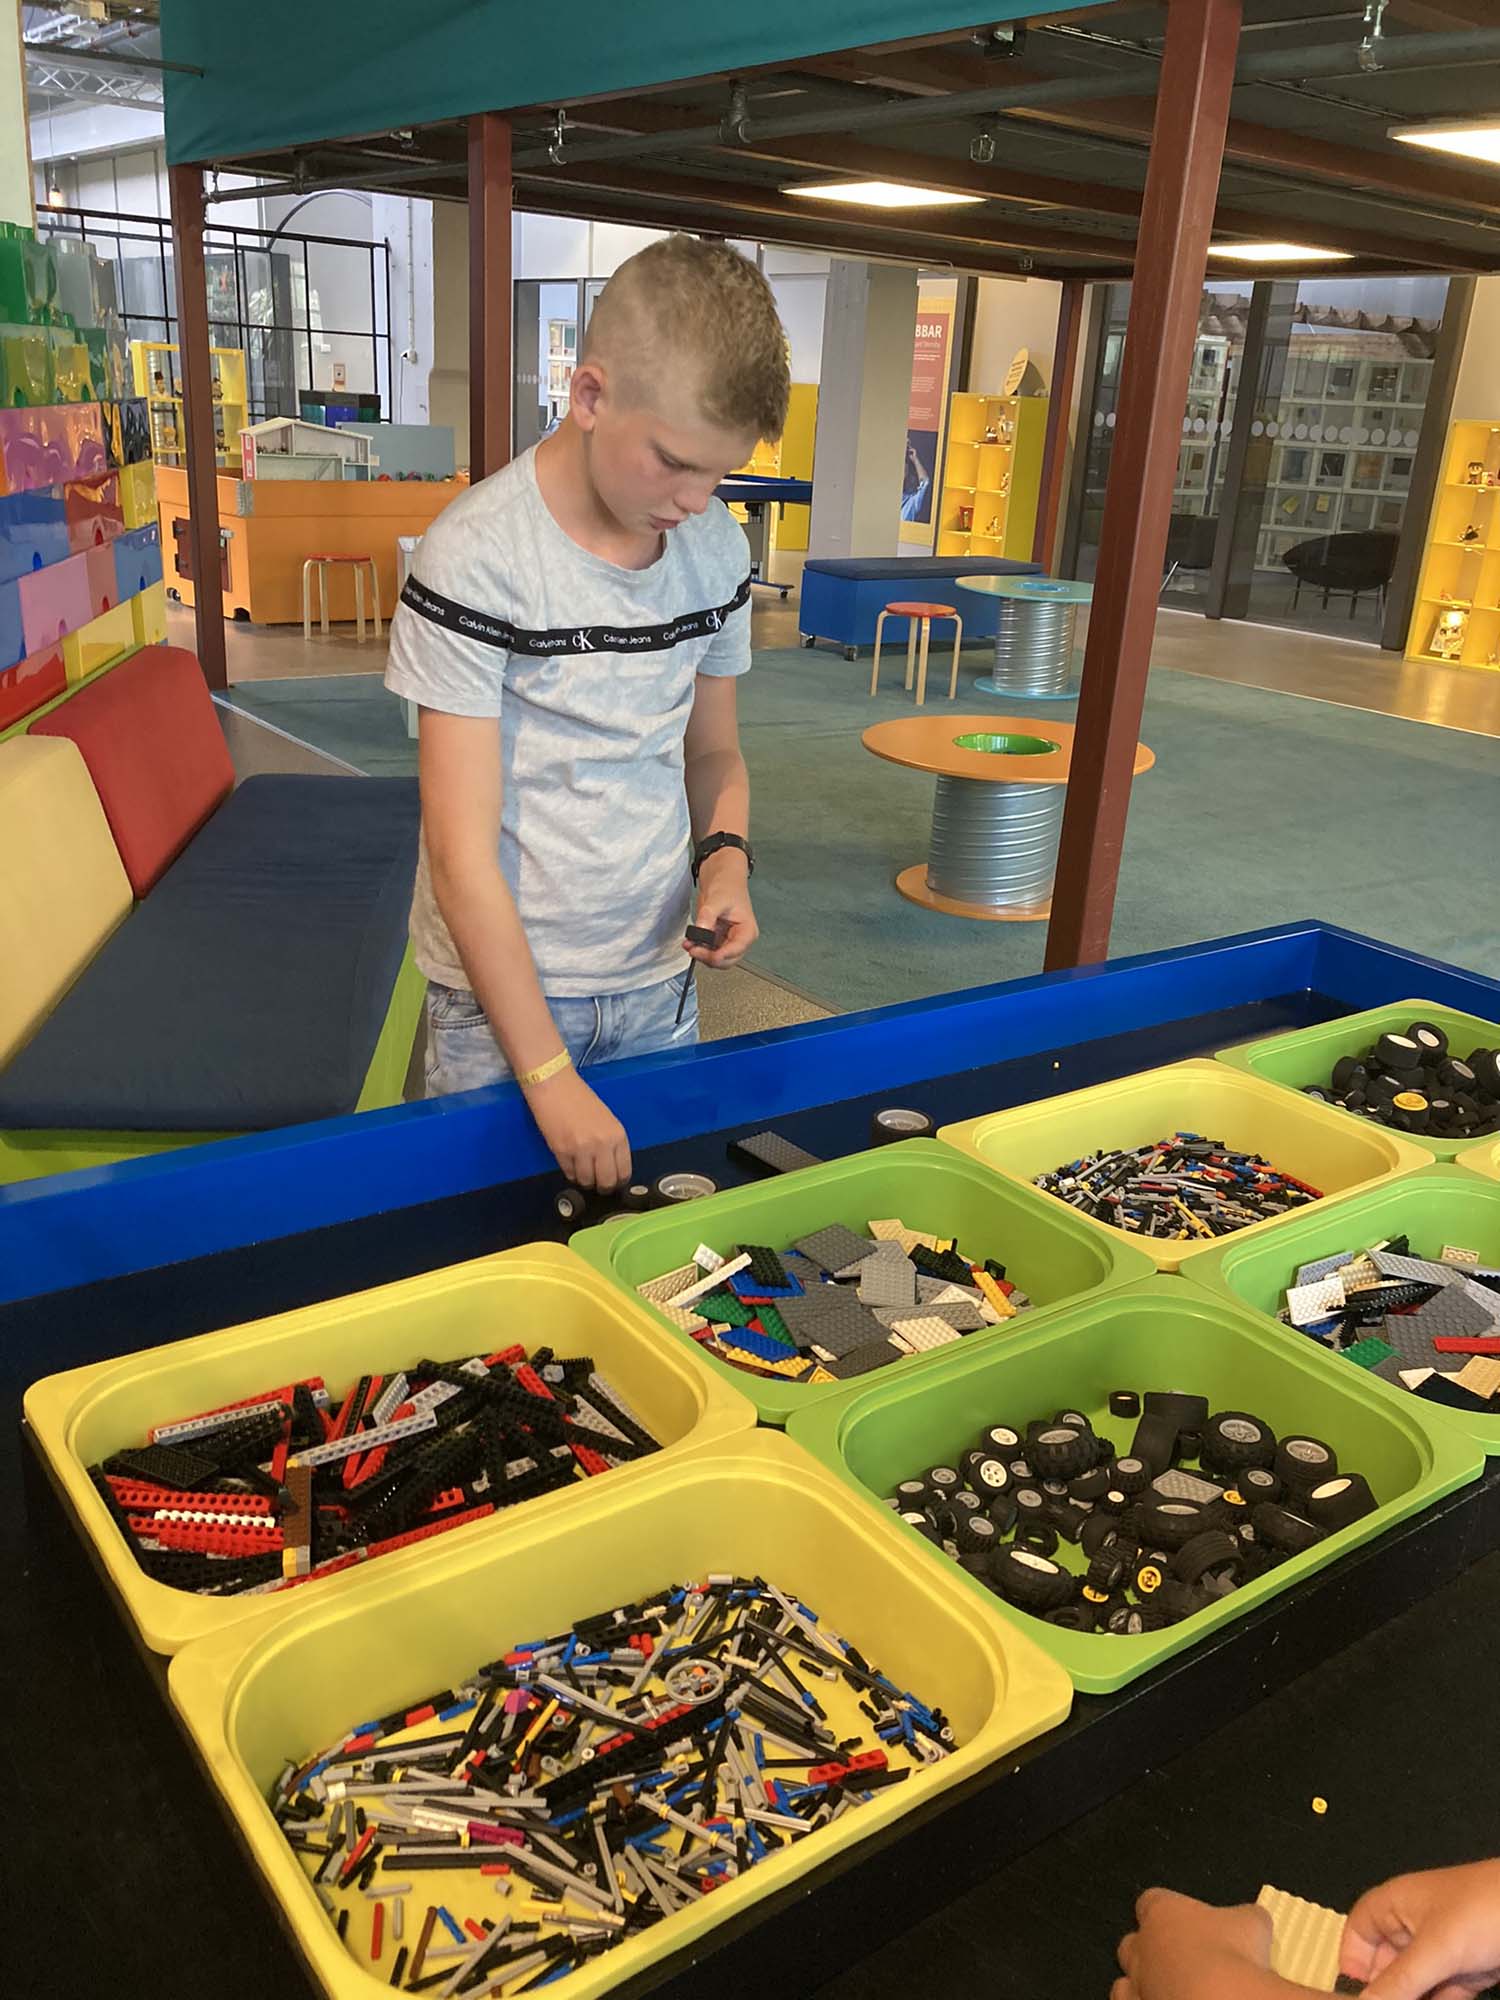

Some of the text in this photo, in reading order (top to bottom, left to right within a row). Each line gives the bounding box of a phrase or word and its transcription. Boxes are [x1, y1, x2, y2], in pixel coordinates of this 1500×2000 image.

[915, 324, 942, 338] BBAR
[459, 616, 486, 632] Calvin
[629, 635, 652, 644] Jeans
